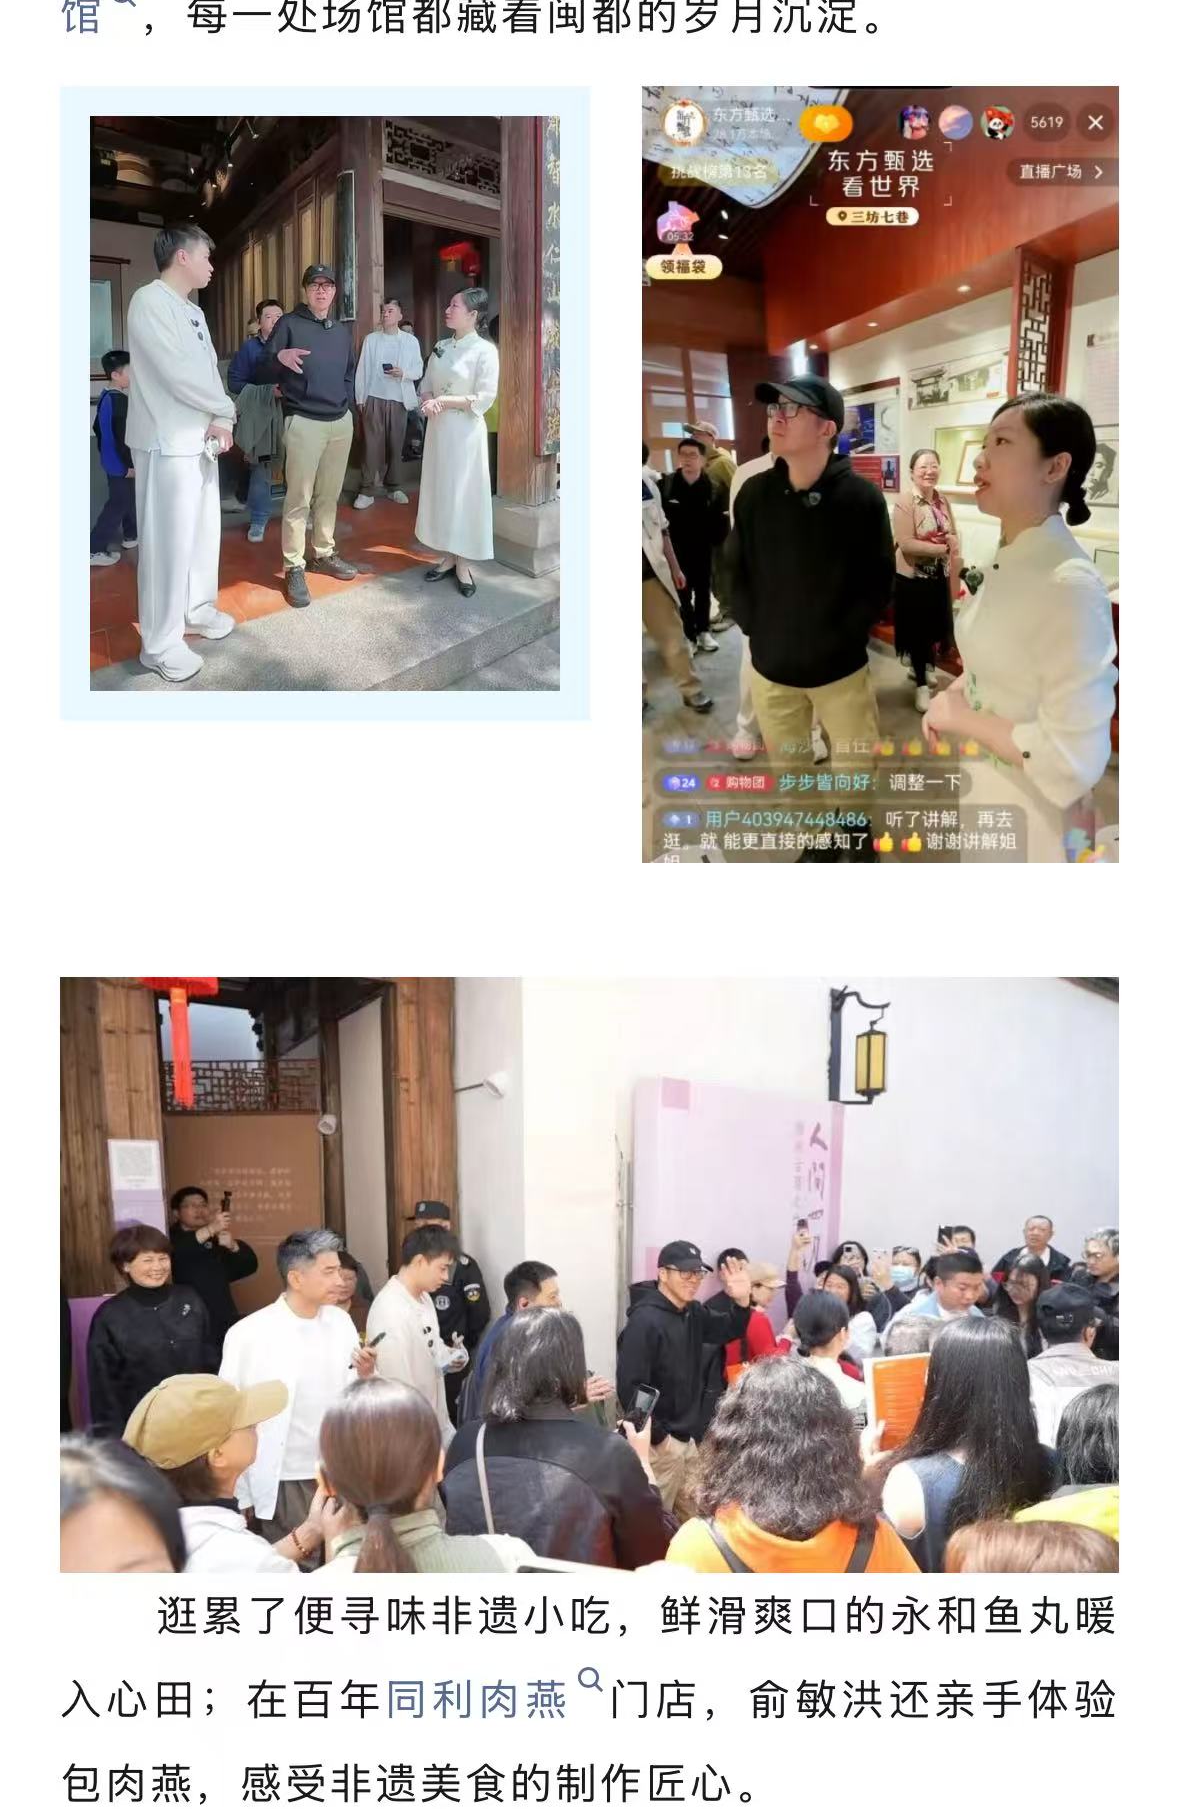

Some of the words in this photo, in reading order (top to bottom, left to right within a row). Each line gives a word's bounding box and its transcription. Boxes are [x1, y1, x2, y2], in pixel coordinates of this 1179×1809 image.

[1031, 115, 1064, 129] 5619
[828, 149, 935, 172] 东方甄选
[1019, 163, 1083, 180] 直播广场
[841, 175, 920, 198] 看世界
[851, 211, 909, 224] 三坊七巷
[660, 259, 706, 274] 领福袋
[681, 778, 696, 789] 24
[726, 776, 765, 789] 购物团
[889, 774, 962, 791] 调整一下
[724, 832, 868, 851] 能更直接的感知了
[926, 833, 1017, 851] 谢谢讲解姐
